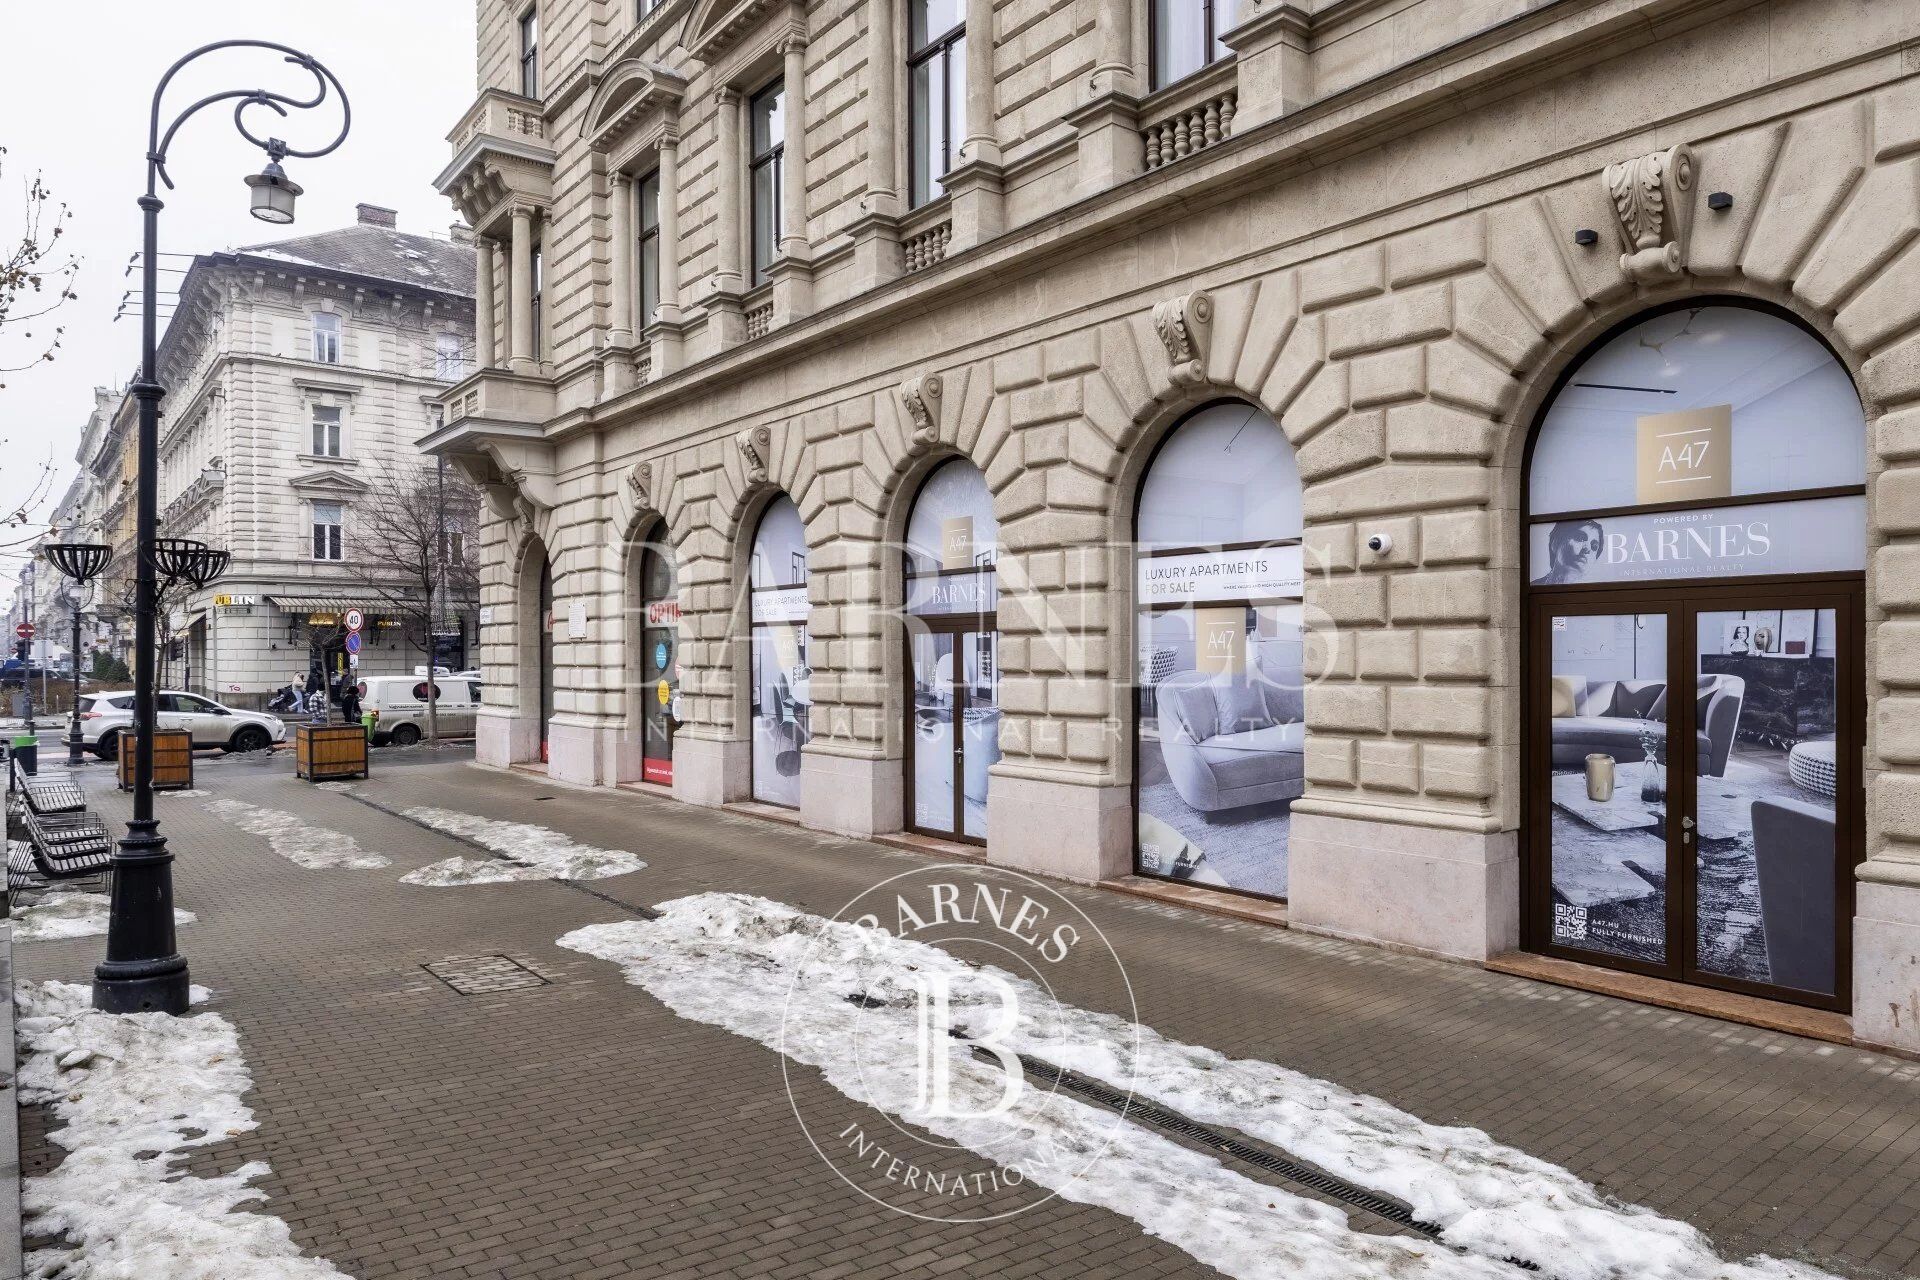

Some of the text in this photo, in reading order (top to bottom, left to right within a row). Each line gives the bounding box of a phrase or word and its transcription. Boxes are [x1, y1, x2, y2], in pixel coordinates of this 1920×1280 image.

[1657, 439, 1710, 473] A47
[1653, 513, 1714, 525] POWERED BY
[949, 535, 967, 552] A47
[1603, 521, 1771, 565] BARNES
[1145, 560, 1268, 580] LUXURY APARTMENTS
[932, 582, 986, 605] BARNES
[1145, 581, 1195, 595] FOR SALE
[349, 615, 359, 625] 40
[1207, 630, 1236, 650] A47
[1592, 919, 1619, 928] A47.HU
[1592, 928, 1664, 945] FULLY FURNISHED
